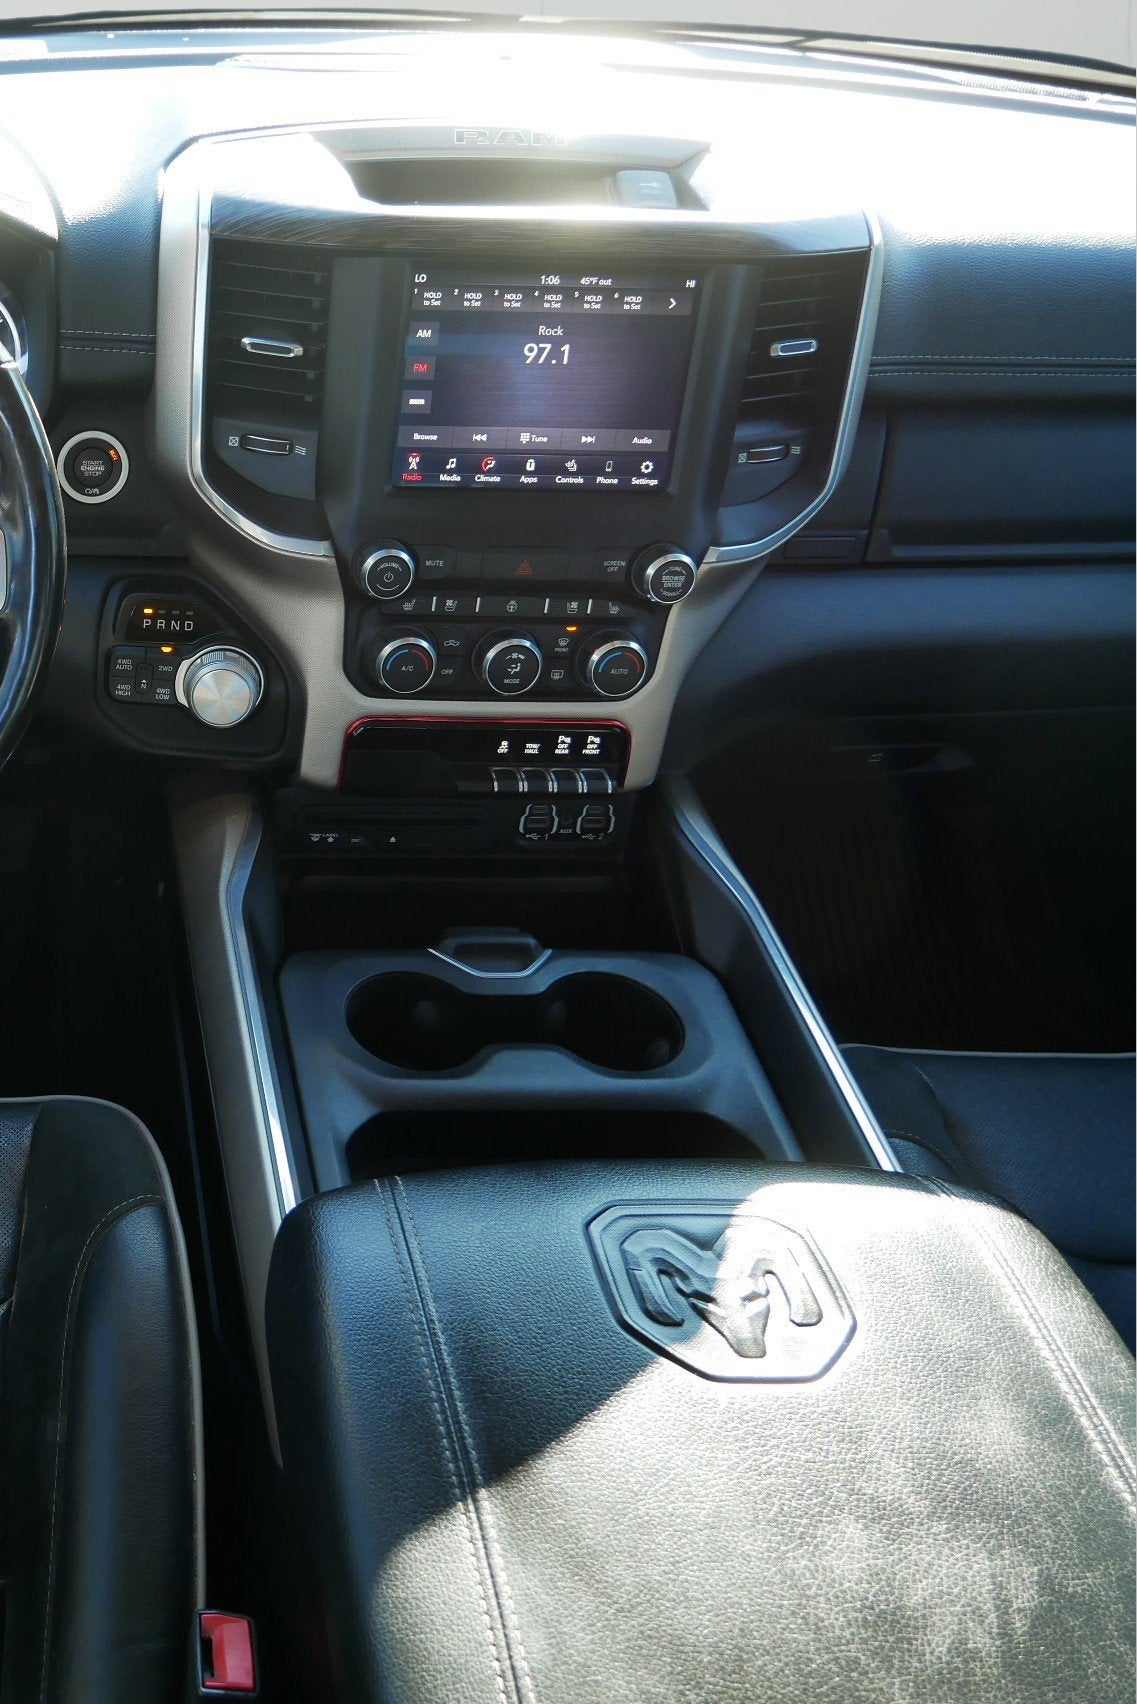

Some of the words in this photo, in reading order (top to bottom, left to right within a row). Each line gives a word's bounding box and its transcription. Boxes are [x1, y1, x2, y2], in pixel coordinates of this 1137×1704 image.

[454, 129, 568, 146] RAM
[415, 274, 426, 282] LO
[541, 276, 560, 284] 1:06
[686, 280, 695, 288] HI
[539, 326, 563, 336] Rock
[524, 343, 570, 364] 97.1
[414, 364, 429, 372] FM
[632, 477, 658, 485] Settings
[143, 619, 151, 628] P
[157, 620, 165, 629] R
[171, 621, 179, 630] N
[185, 621, 193, 630] D
